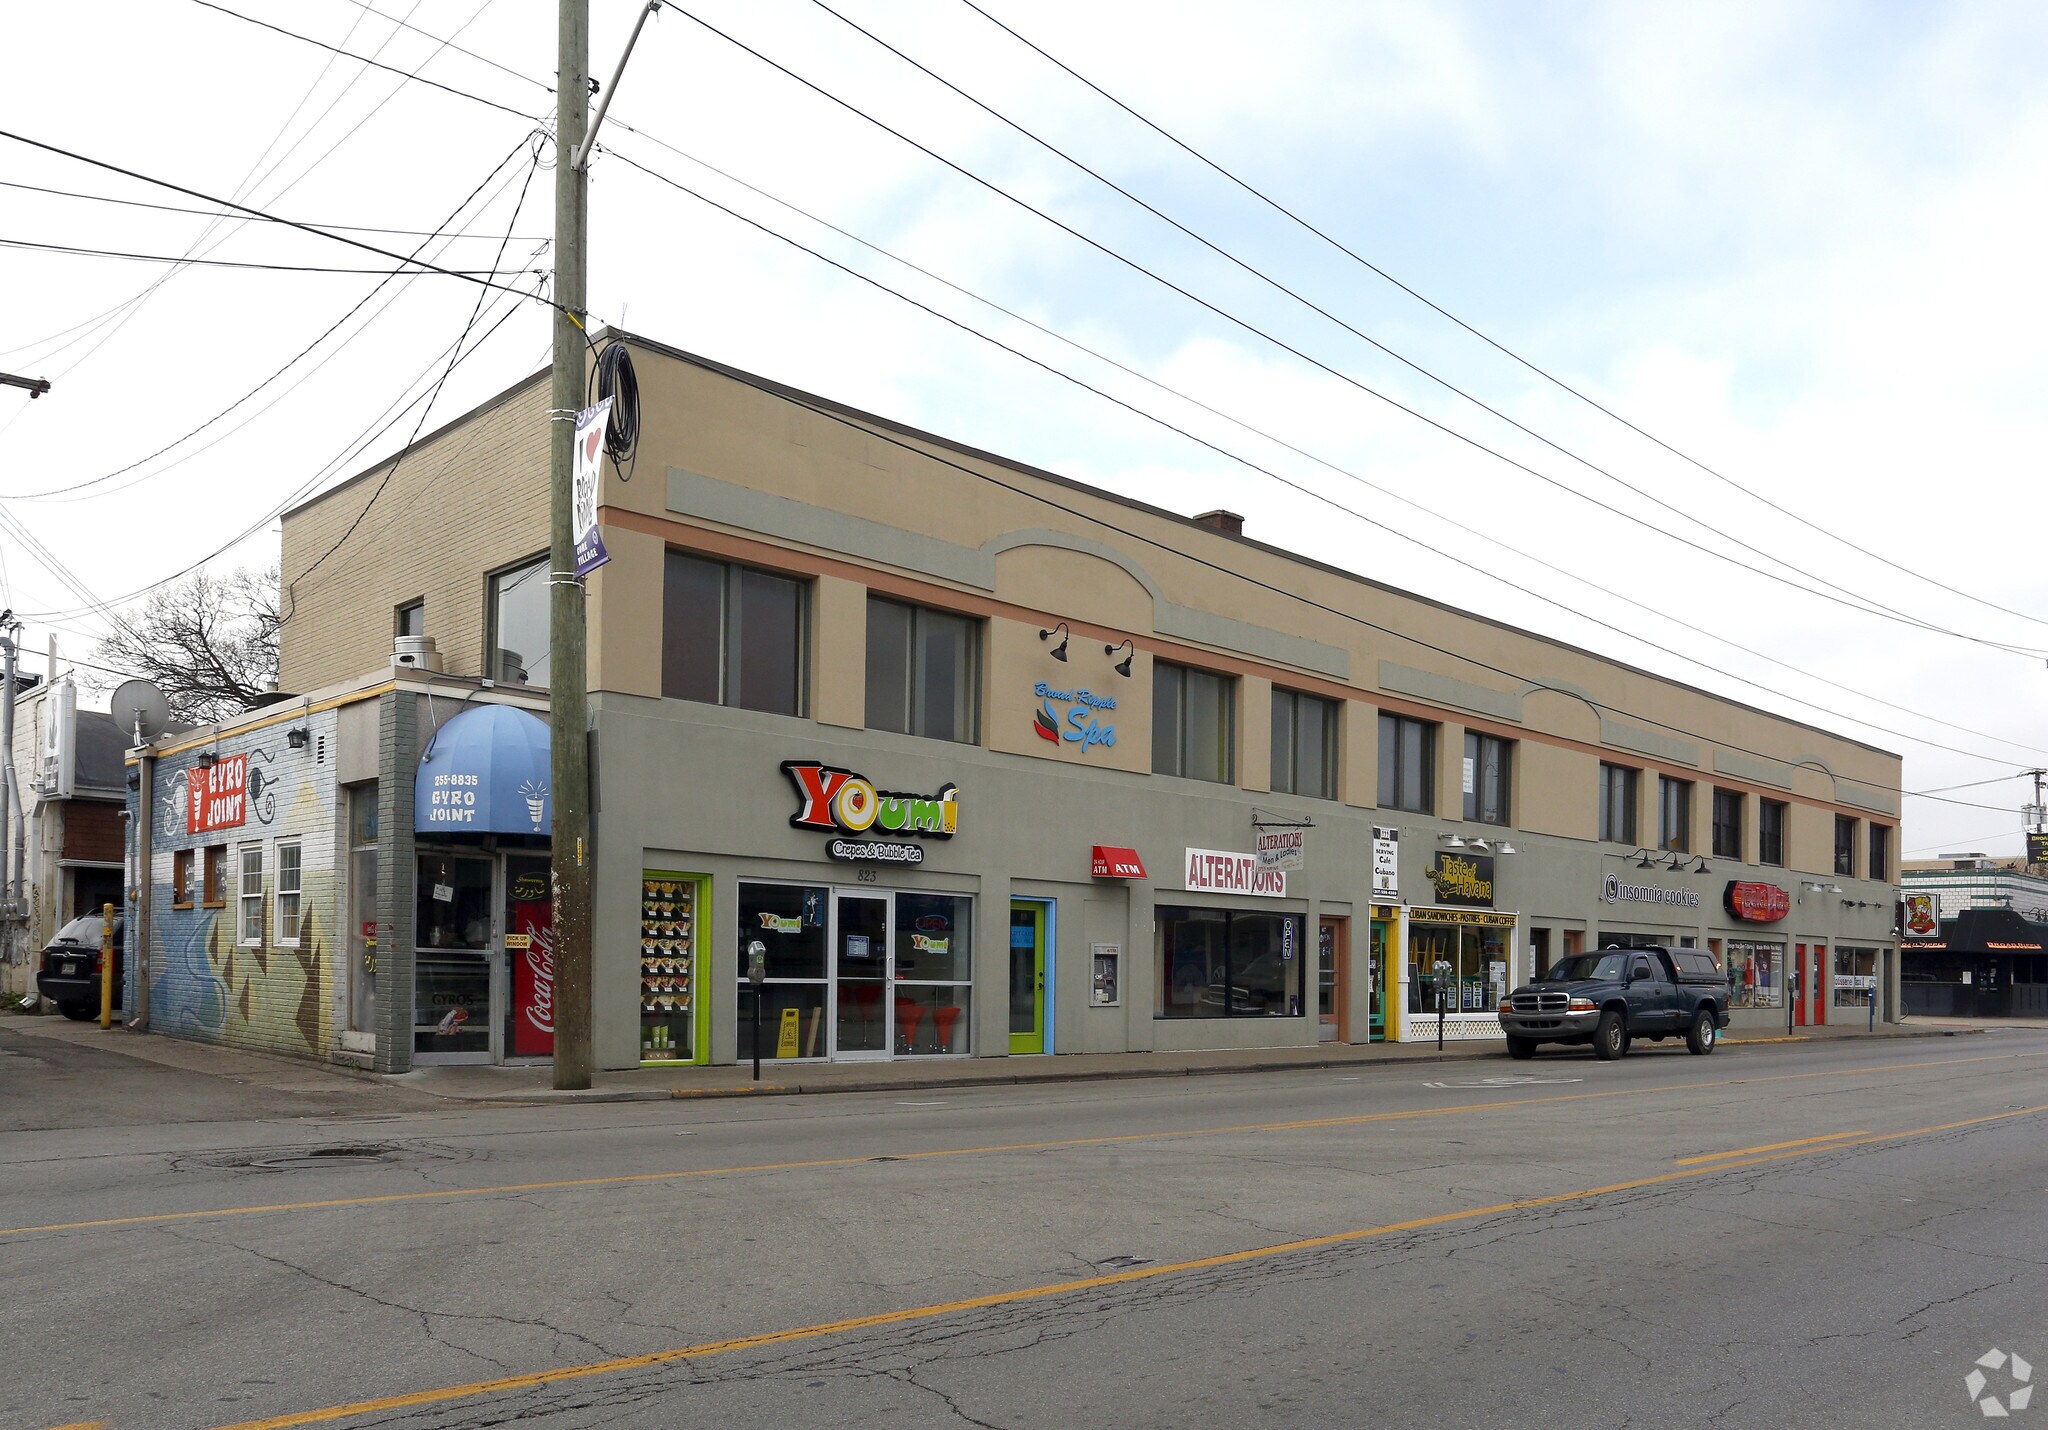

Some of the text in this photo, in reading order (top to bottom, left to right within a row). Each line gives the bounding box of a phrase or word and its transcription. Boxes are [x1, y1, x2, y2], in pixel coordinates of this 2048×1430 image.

[576, 541, 588, 556] CORE
[577, 547, 599, 566] VILLAGE
[1076, 689, 1117, 711] Ripple
[1063, 706, 1118, 753] Spa
[209, 758, 244, 794] GYRO
[434, 774, 478, 787] 255-8835
[431, 790, 476, 806] GYRO
[207, 794, 243, 827] JOINT
[429, 808, 475, 823] JOINT
[1257, 831, 1303, 851] ALTERATIONS
[833, 840, 922, 862] Crepes & Bubble Tea
[1262, 849, 1297, 865] Men & Ladies
[1379, 856, 1391, 864] Café
[857, 869, 877, 883] 823
[1093, 865, 1108, 874] ATM
[1115, 863, 1141, 875] ATM
[1188, 853, 1284, 893] ALTERATIONS
[1375, 867, 1395, 876] Cubano
[1441, 855, 1477, 878] Taste of
[1455, 876, 1492, 900] Havana
[1618, 880, 1699, 908] insomnia cookies
[1409, 909, 1516, 926] CUBAN SANDWICHES PASTRIES CUBAN COFFEE
[1283, 920, 1292, 957] OPEN
[525, 919, 554, 1033] Coca-Cola
[432, 993, 474, 1006] GYROS
